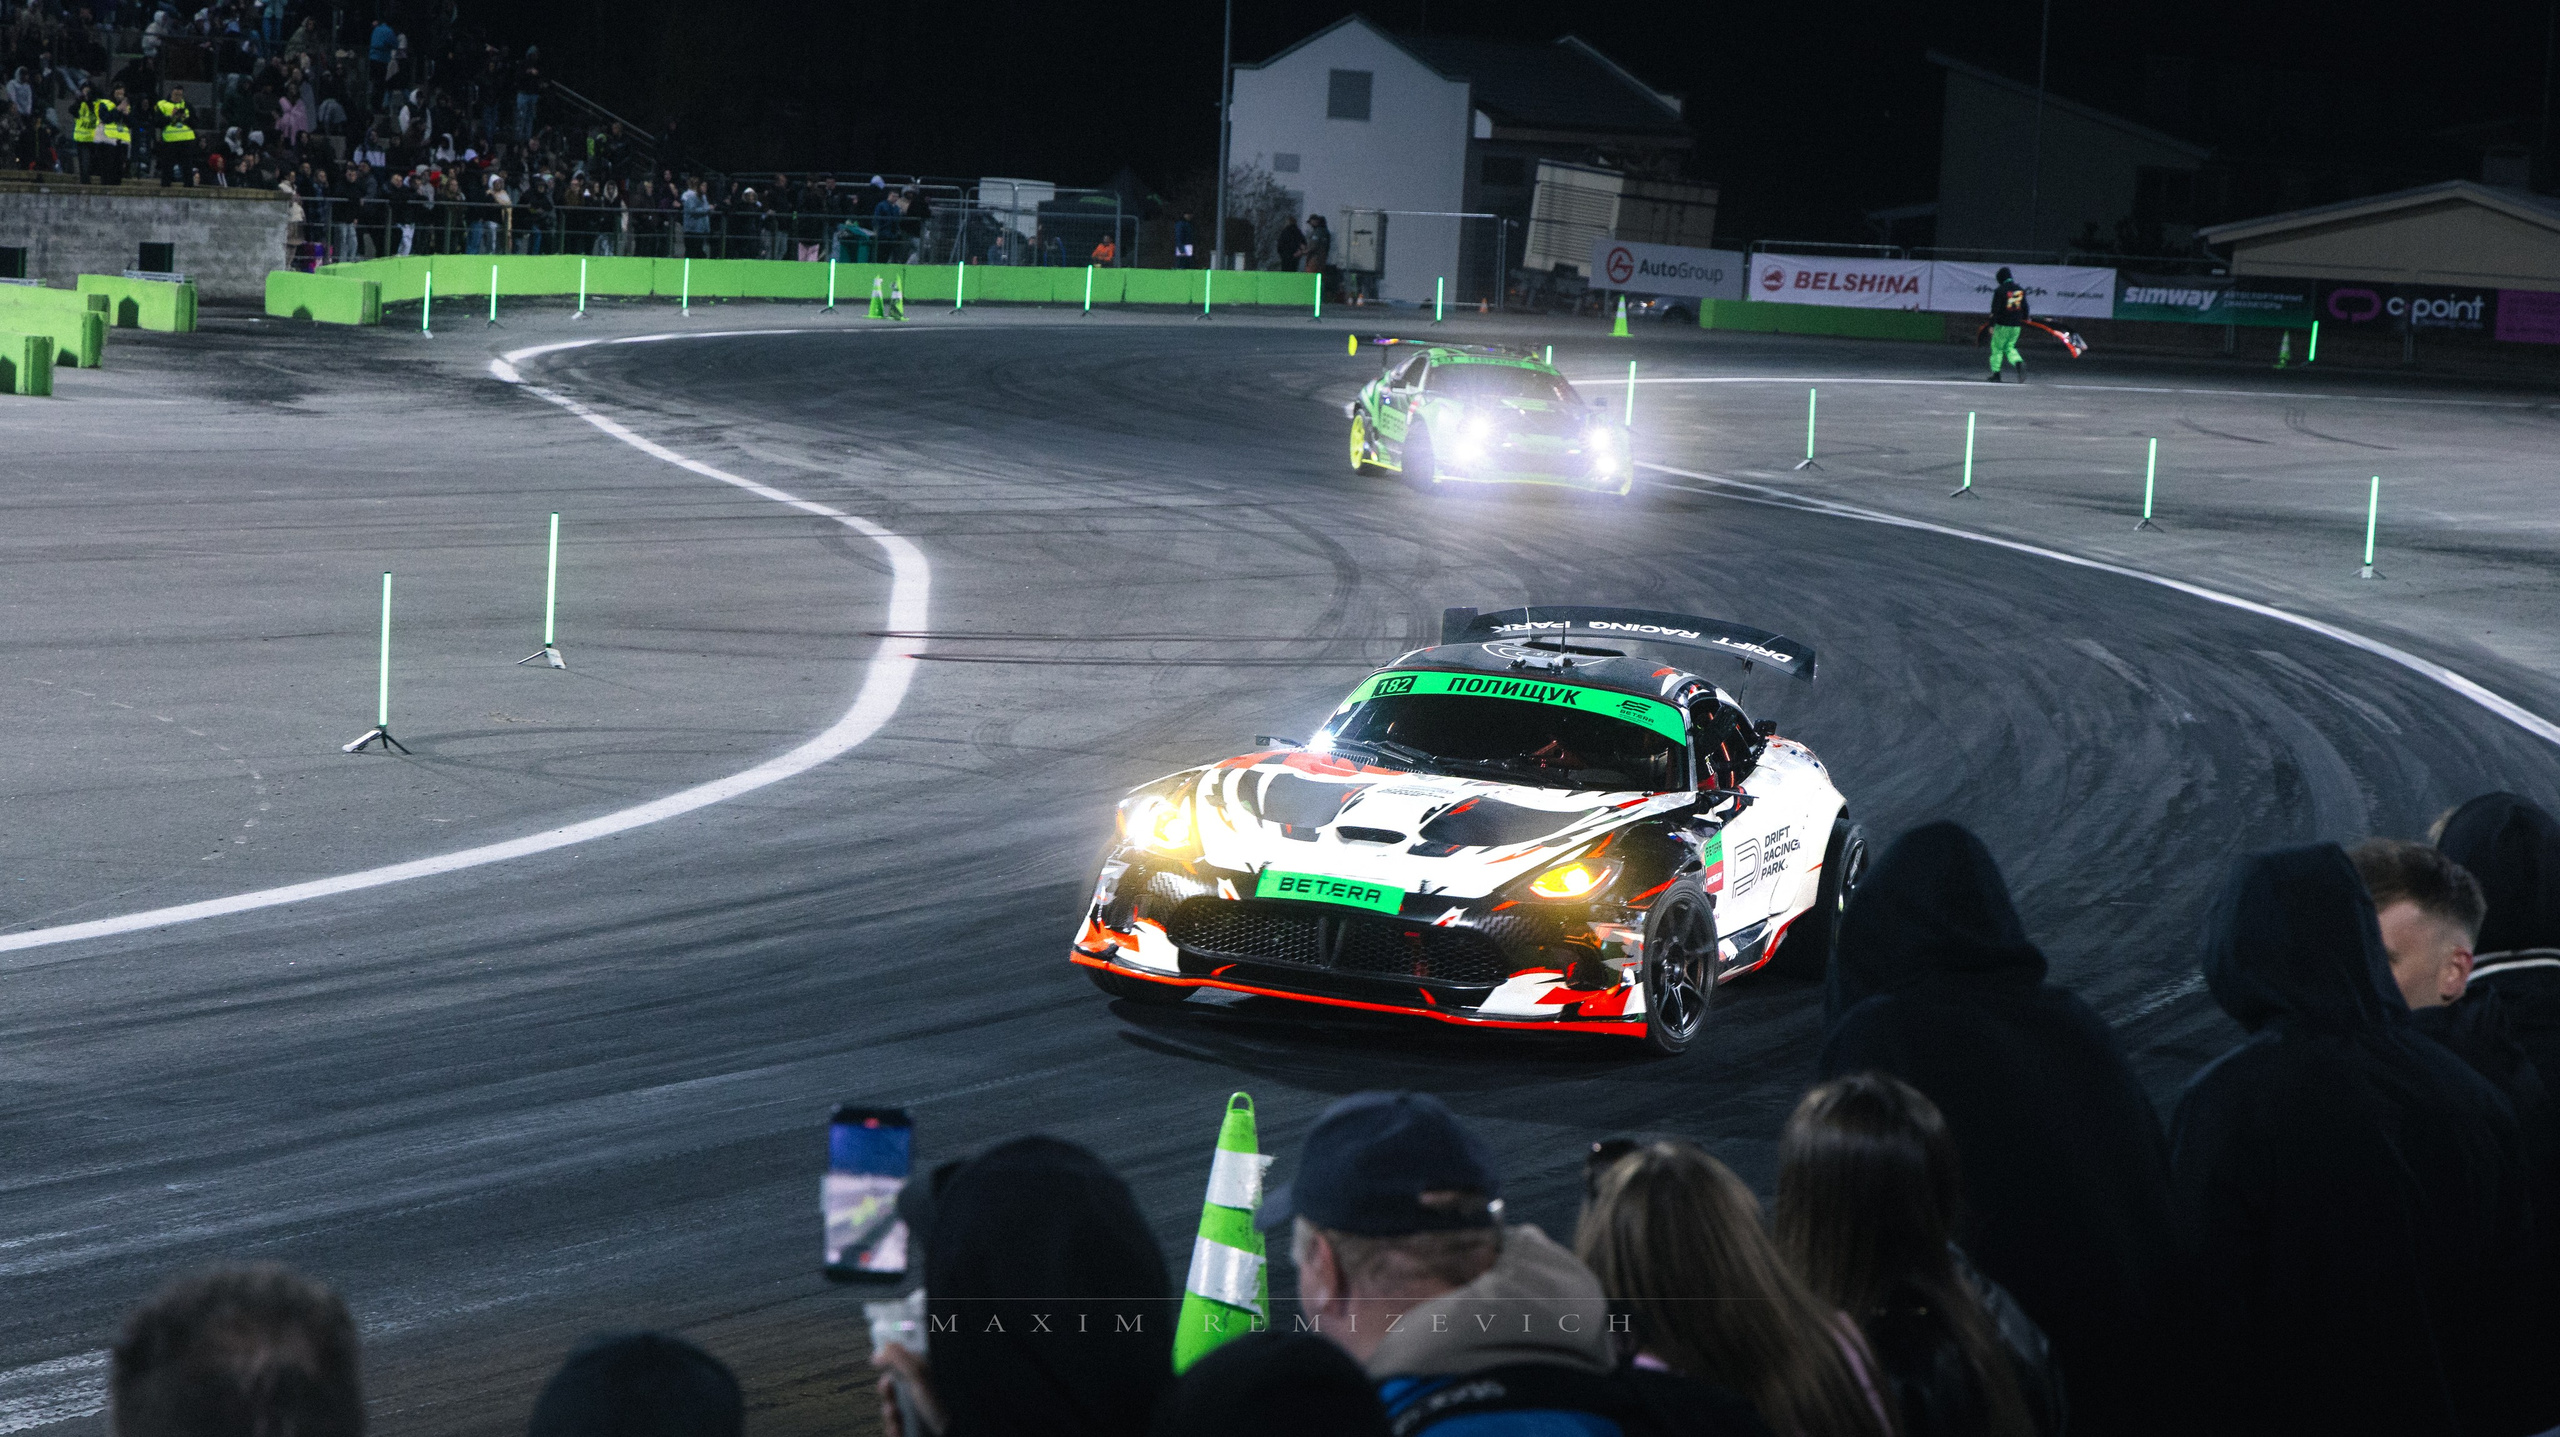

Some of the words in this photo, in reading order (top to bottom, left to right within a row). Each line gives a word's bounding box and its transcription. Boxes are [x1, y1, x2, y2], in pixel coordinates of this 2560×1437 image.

[1638, 258, 1724, 284] AutoGroup
[2123, 286, 2218, 311] simway
[1491, 620, 1571, 635] PARK
[1588, 620, 1701, 640] RACING
[1712, 636, 1795, 664] DRIFT
[1379, 679, 1410, 695] 182
[1447, 677, 1582, 706] ПОЛИЩУК
[1620, 709, 1655, 723] BETERA
[1764, 825, 1791, 848] DRIFT
[1763, 839, 1800, 864] RACING
[1760, 858, 1786, 880] PARK
[1279, 876, 1382, 904] BETERA
